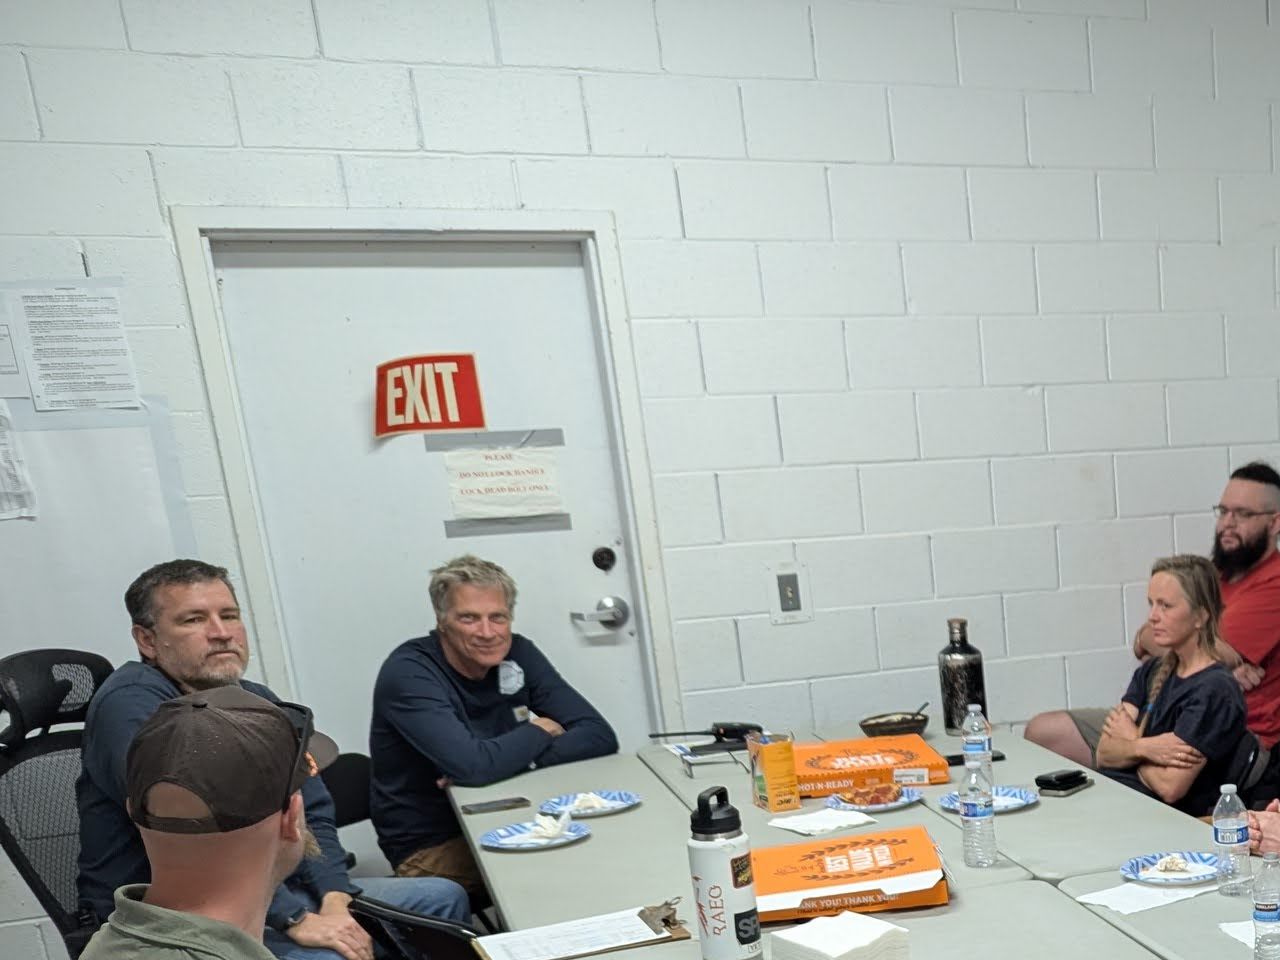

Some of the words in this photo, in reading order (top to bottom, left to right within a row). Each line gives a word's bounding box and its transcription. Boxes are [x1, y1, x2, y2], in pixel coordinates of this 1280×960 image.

[387, 362, 460, 426] EXIT
[460, 488, 485, 496] LOCK
[842, 896, 875, 905] THANK
